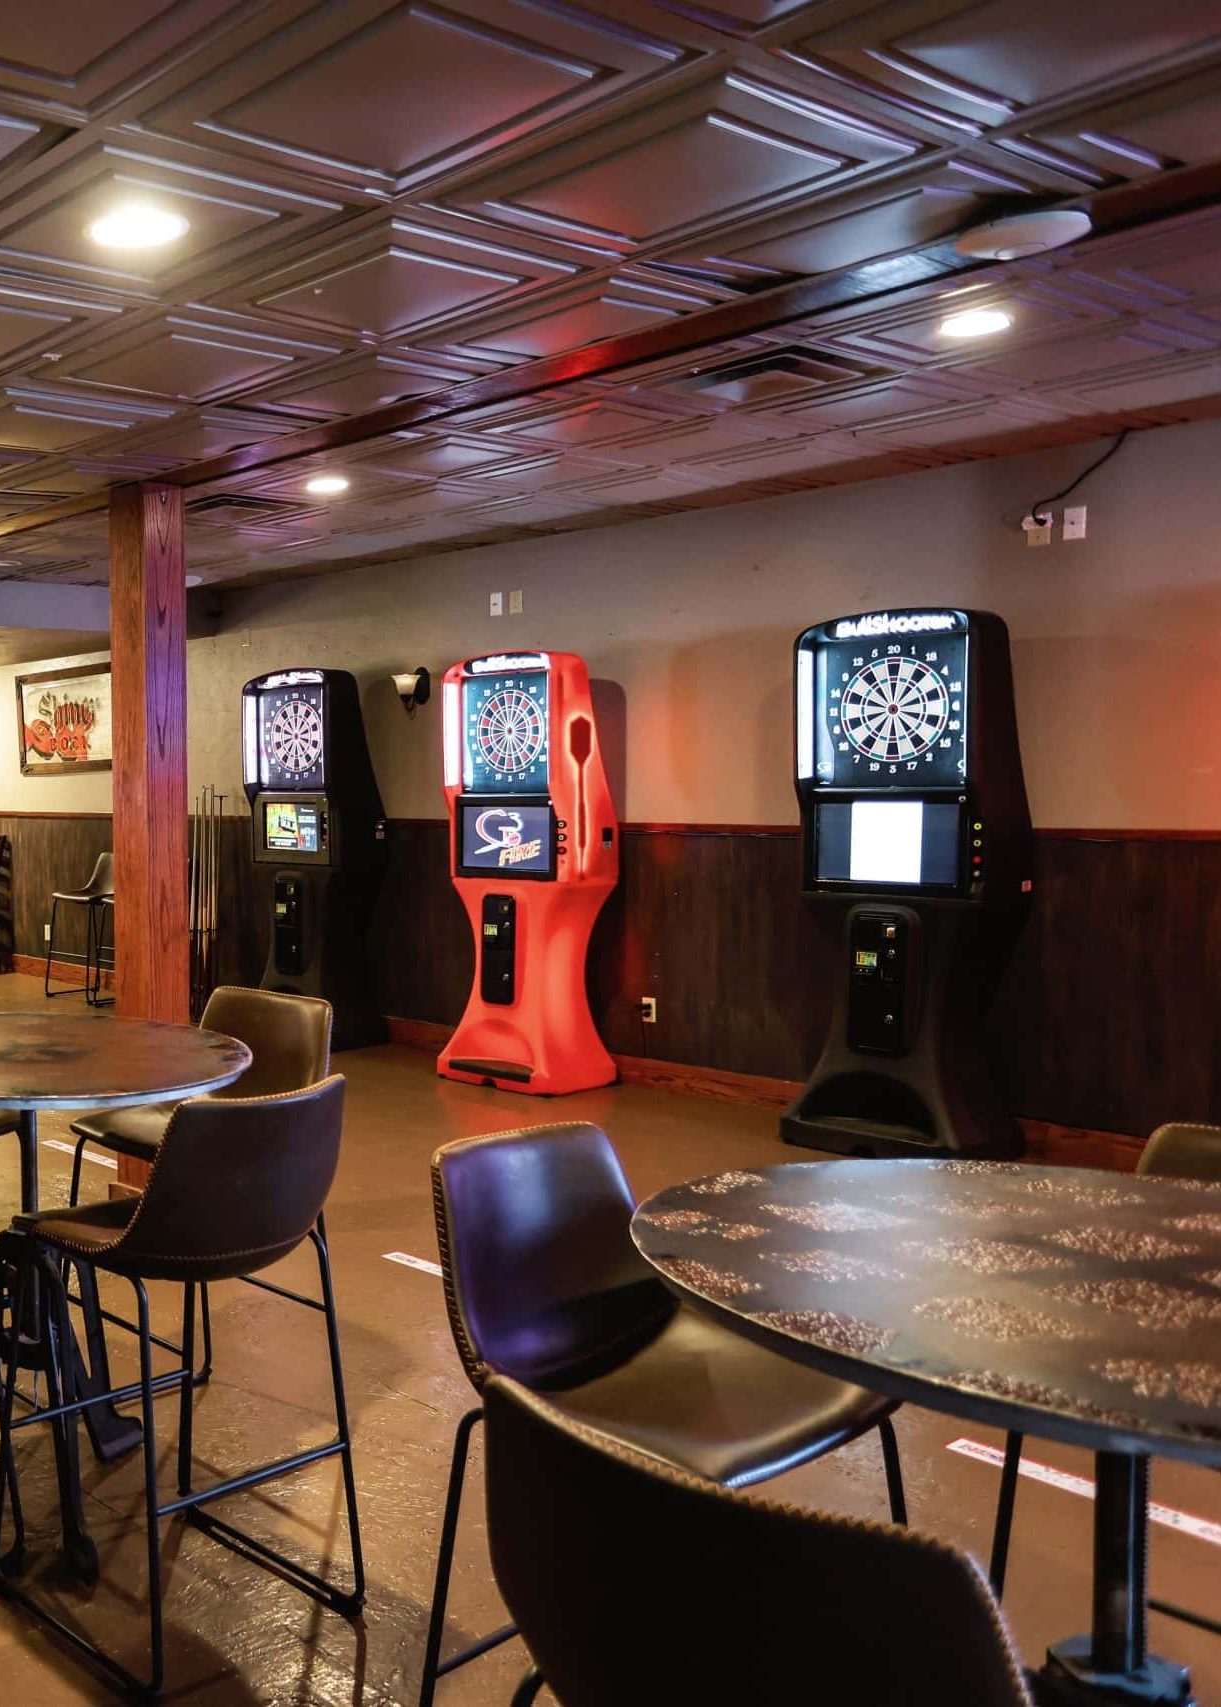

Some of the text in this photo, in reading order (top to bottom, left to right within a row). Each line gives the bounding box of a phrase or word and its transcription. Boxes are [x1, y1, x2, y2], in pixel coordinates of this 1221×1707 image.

[871, 649, 878, 658] 5
[887, 645, 900, 655] 20
[911, 645, 916, 655] 1
[853, 657, 863, 667] 12
[925, 652, 937, 662] 18
[940, 665, 949, 676] 4
[948, 720, 960, 730] 10
[940, 738, 951, 748] 15
[853, 755, 860, 763] 7
[926, 754, 933, 762] 2
[870, 762, 880, 772] 19
[907, 762, 918, 771] 17
[498, 839, 542, 867] FIRE
